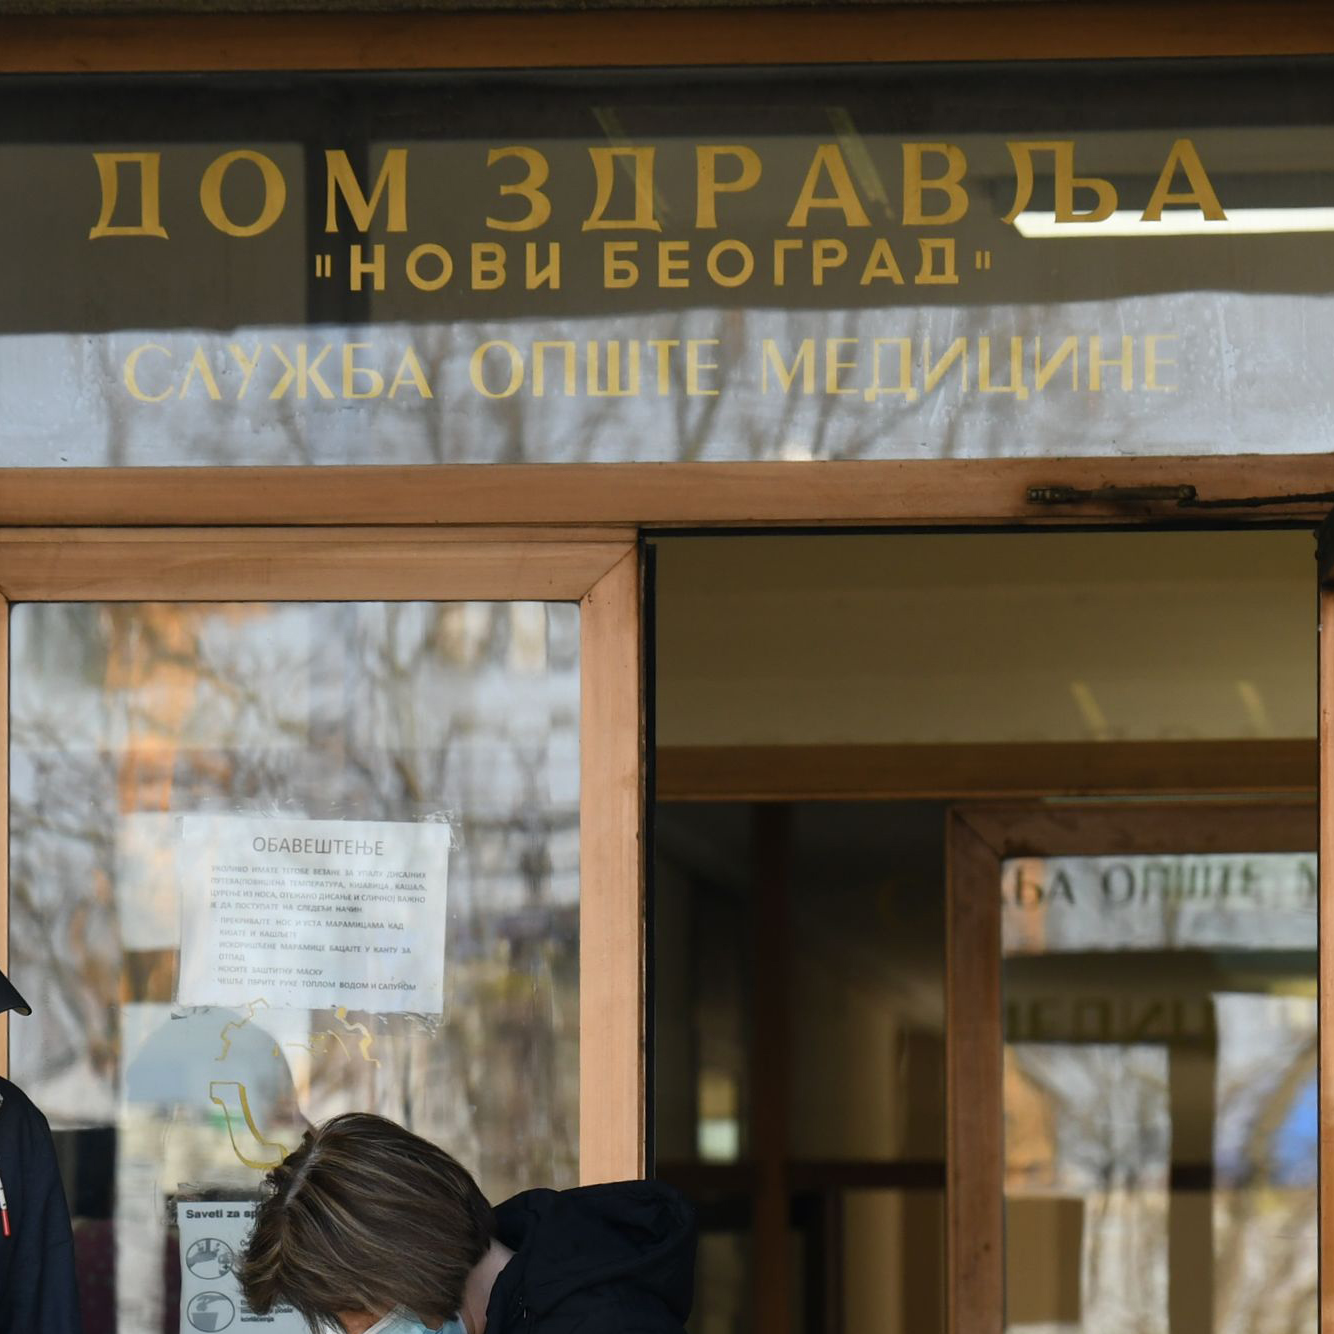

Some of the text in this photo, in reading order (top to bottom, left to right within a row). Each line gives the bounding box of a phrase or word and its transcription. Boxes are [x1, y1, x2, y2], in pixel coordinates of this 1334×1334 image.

[88, 138, 1228, 240] ДОМ ЗДРАВЉА
[122, 334, 1180, 403] СЛУЖБА ОПШТЕ МЕДИЦИНЕ
[252, 836, 384, 856] ОБАВЕШТЕЊЕ
[339, 981, 369, 990] ВОДОМ
[378, 983, 417, 991] САПУНОМ
[185, 1209, 223, 1219] Saveti
[226, 1210, 240, 1219] za
